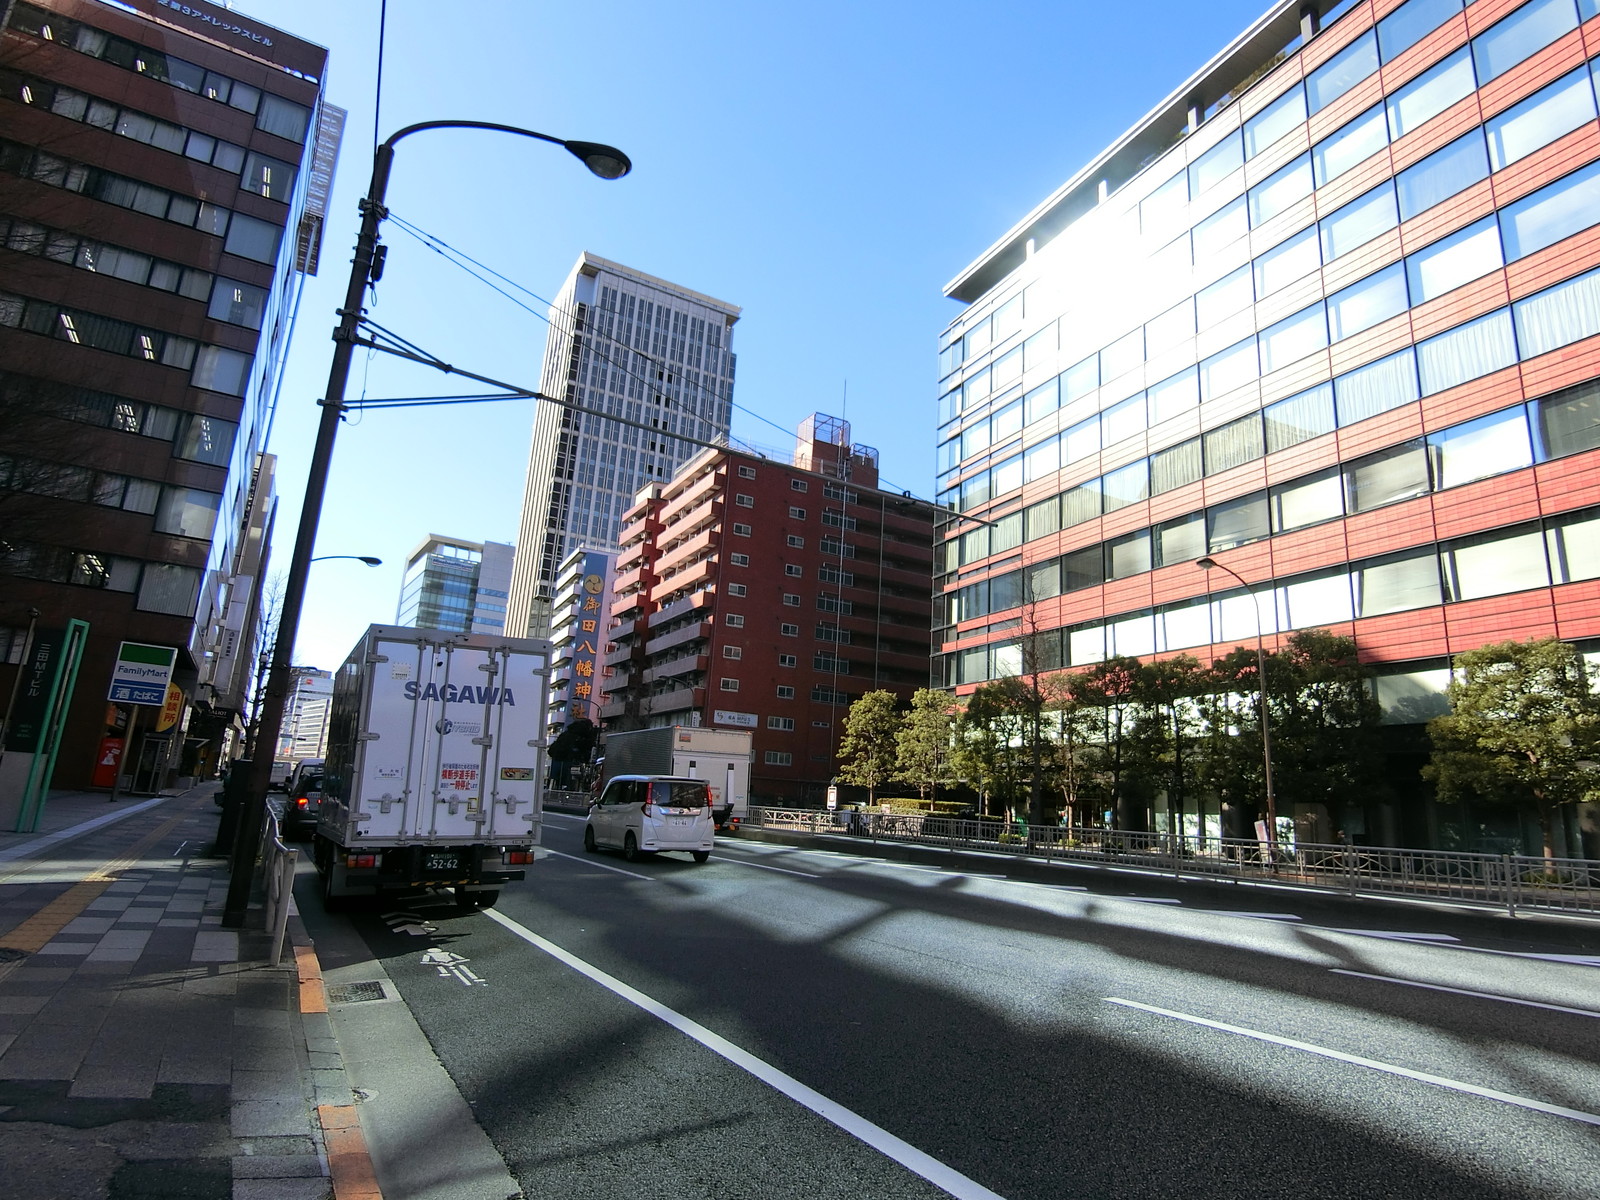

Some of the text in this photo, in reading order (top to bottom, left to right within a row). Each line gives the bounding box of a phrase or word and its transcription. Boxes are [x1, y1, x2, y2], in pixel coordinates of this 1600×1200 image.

[572, 596, 601, 720] 御田八幡神社
[27, 643, 51, 697] 三田MTビル
[117, 665, 168, 678] FamilyMart
[116, 687, 160, 701] 酒 たばこ
[403, 680, 516, 707] SAGAWA
[432, 859, 458, 869] 52-62
